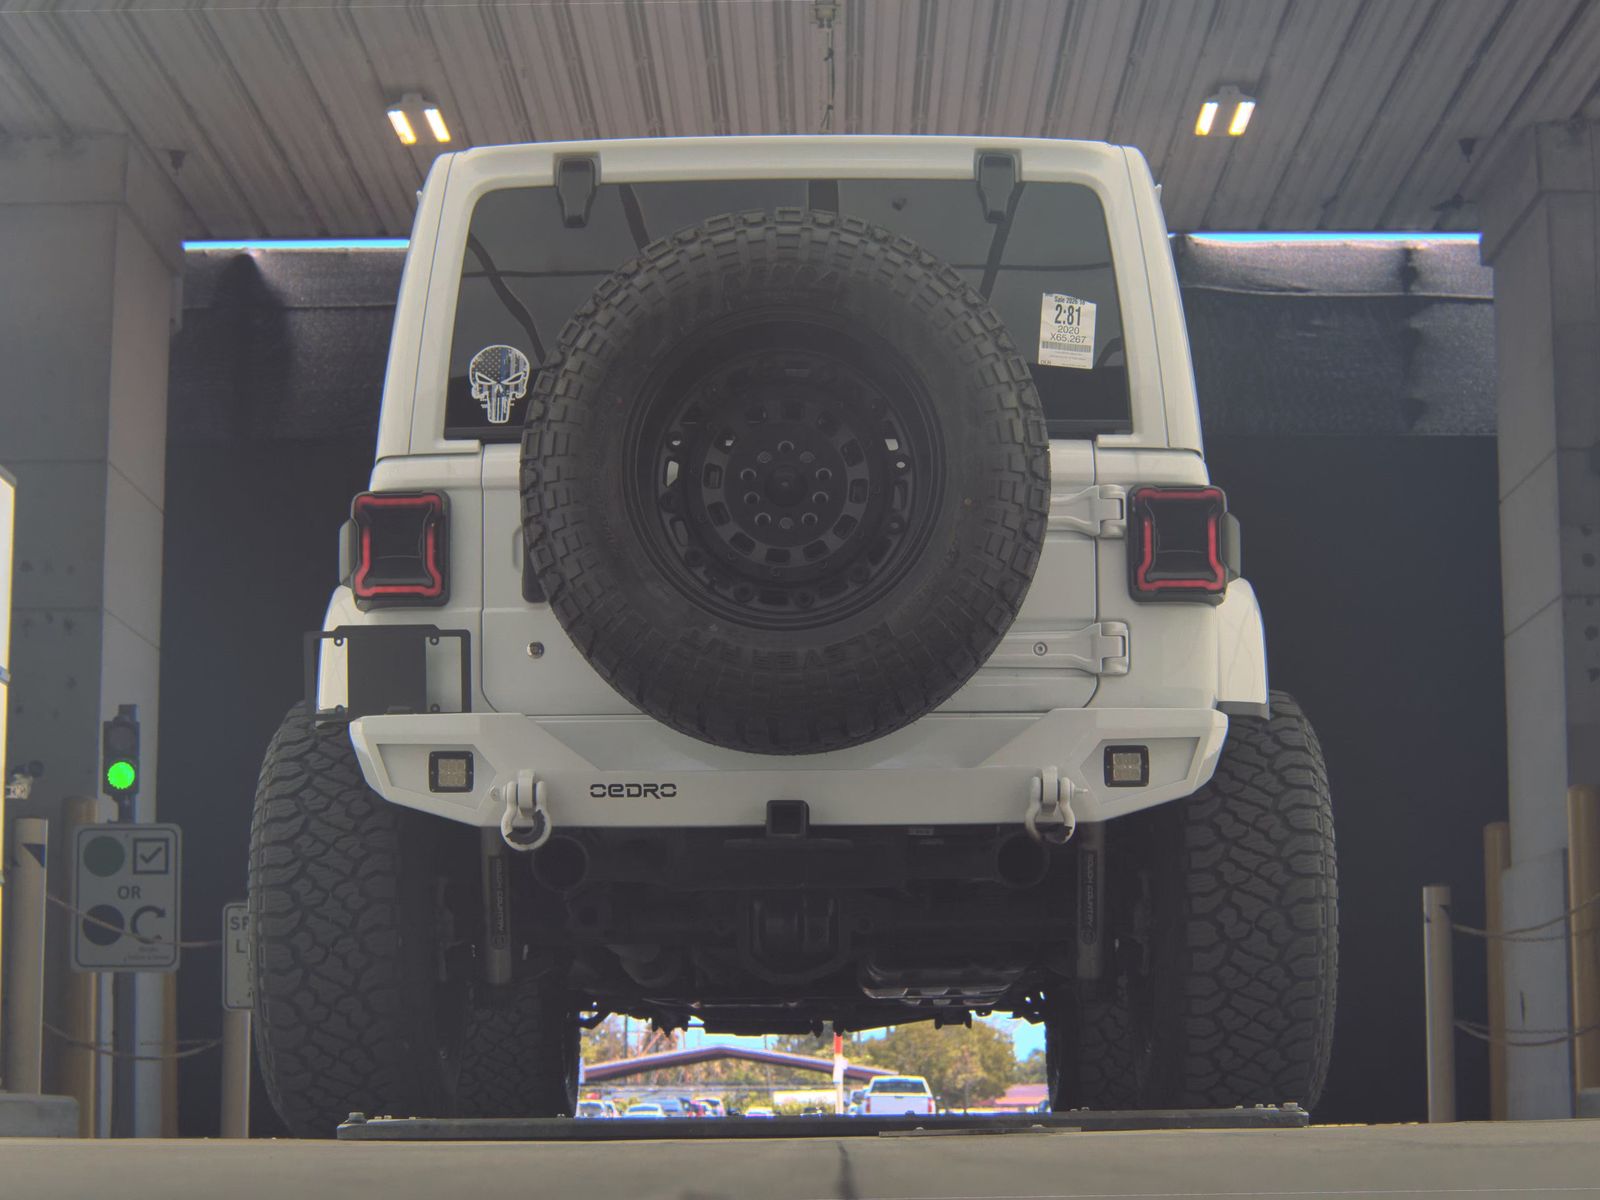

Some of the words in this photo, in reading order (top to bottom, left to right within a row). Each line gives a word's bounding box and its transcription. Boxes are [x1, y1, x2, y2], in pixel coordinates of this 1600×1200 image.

[1054, 304, 1081, 326] 2:81
[1057, 326, 1080, 334] 2020
[1050, 332, 1087, 343] X65.267
[117, 885, 142, 900] OR
